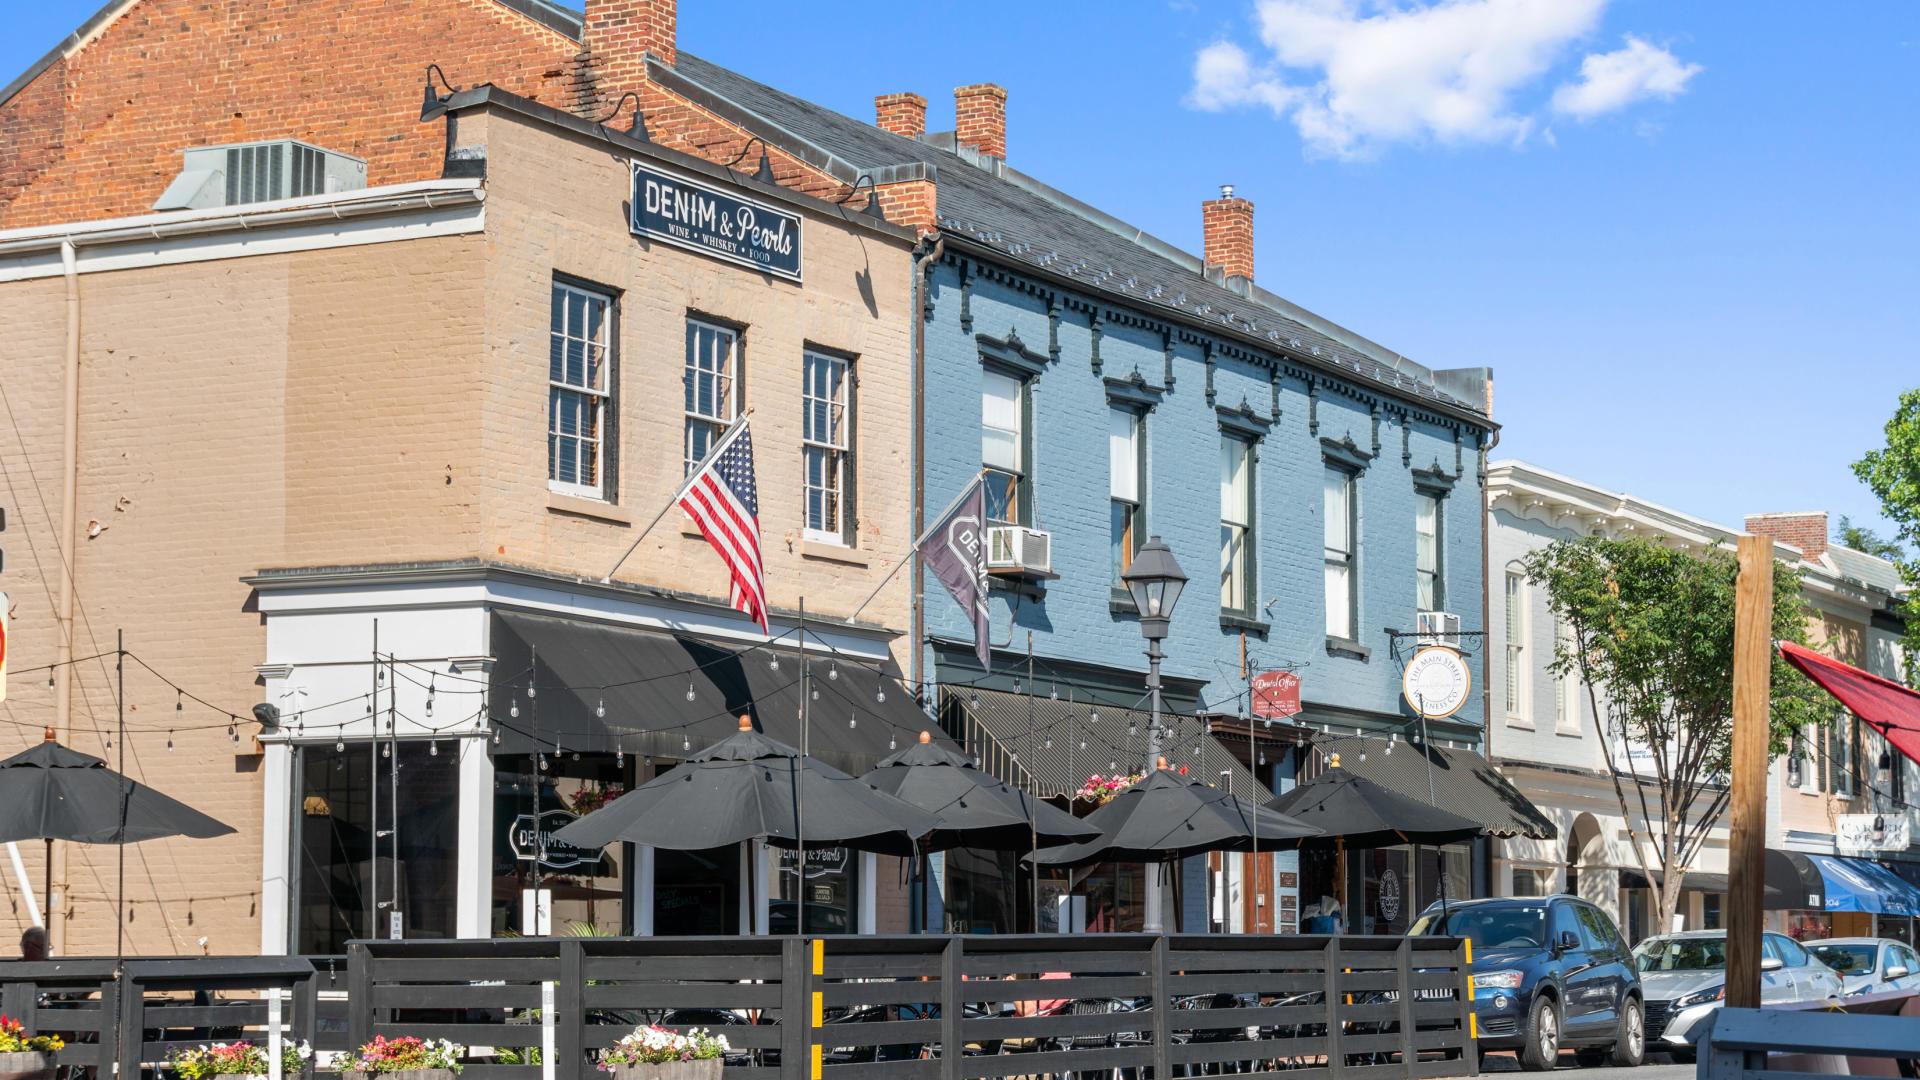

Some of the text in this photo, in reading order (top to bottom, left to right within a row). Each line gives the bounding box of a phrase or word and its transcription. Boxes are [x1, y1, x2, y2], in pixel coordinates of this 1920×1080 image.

[645, 180, 793, 256] DENIM & Pearls
[668, 223, 770, 263] WINE WHISKEY FOOD
[1278, 675, 1297, 691] Office
[1420, 655, 1442, 666] MAIN
[1444, 657, 1462, 681] STREET
